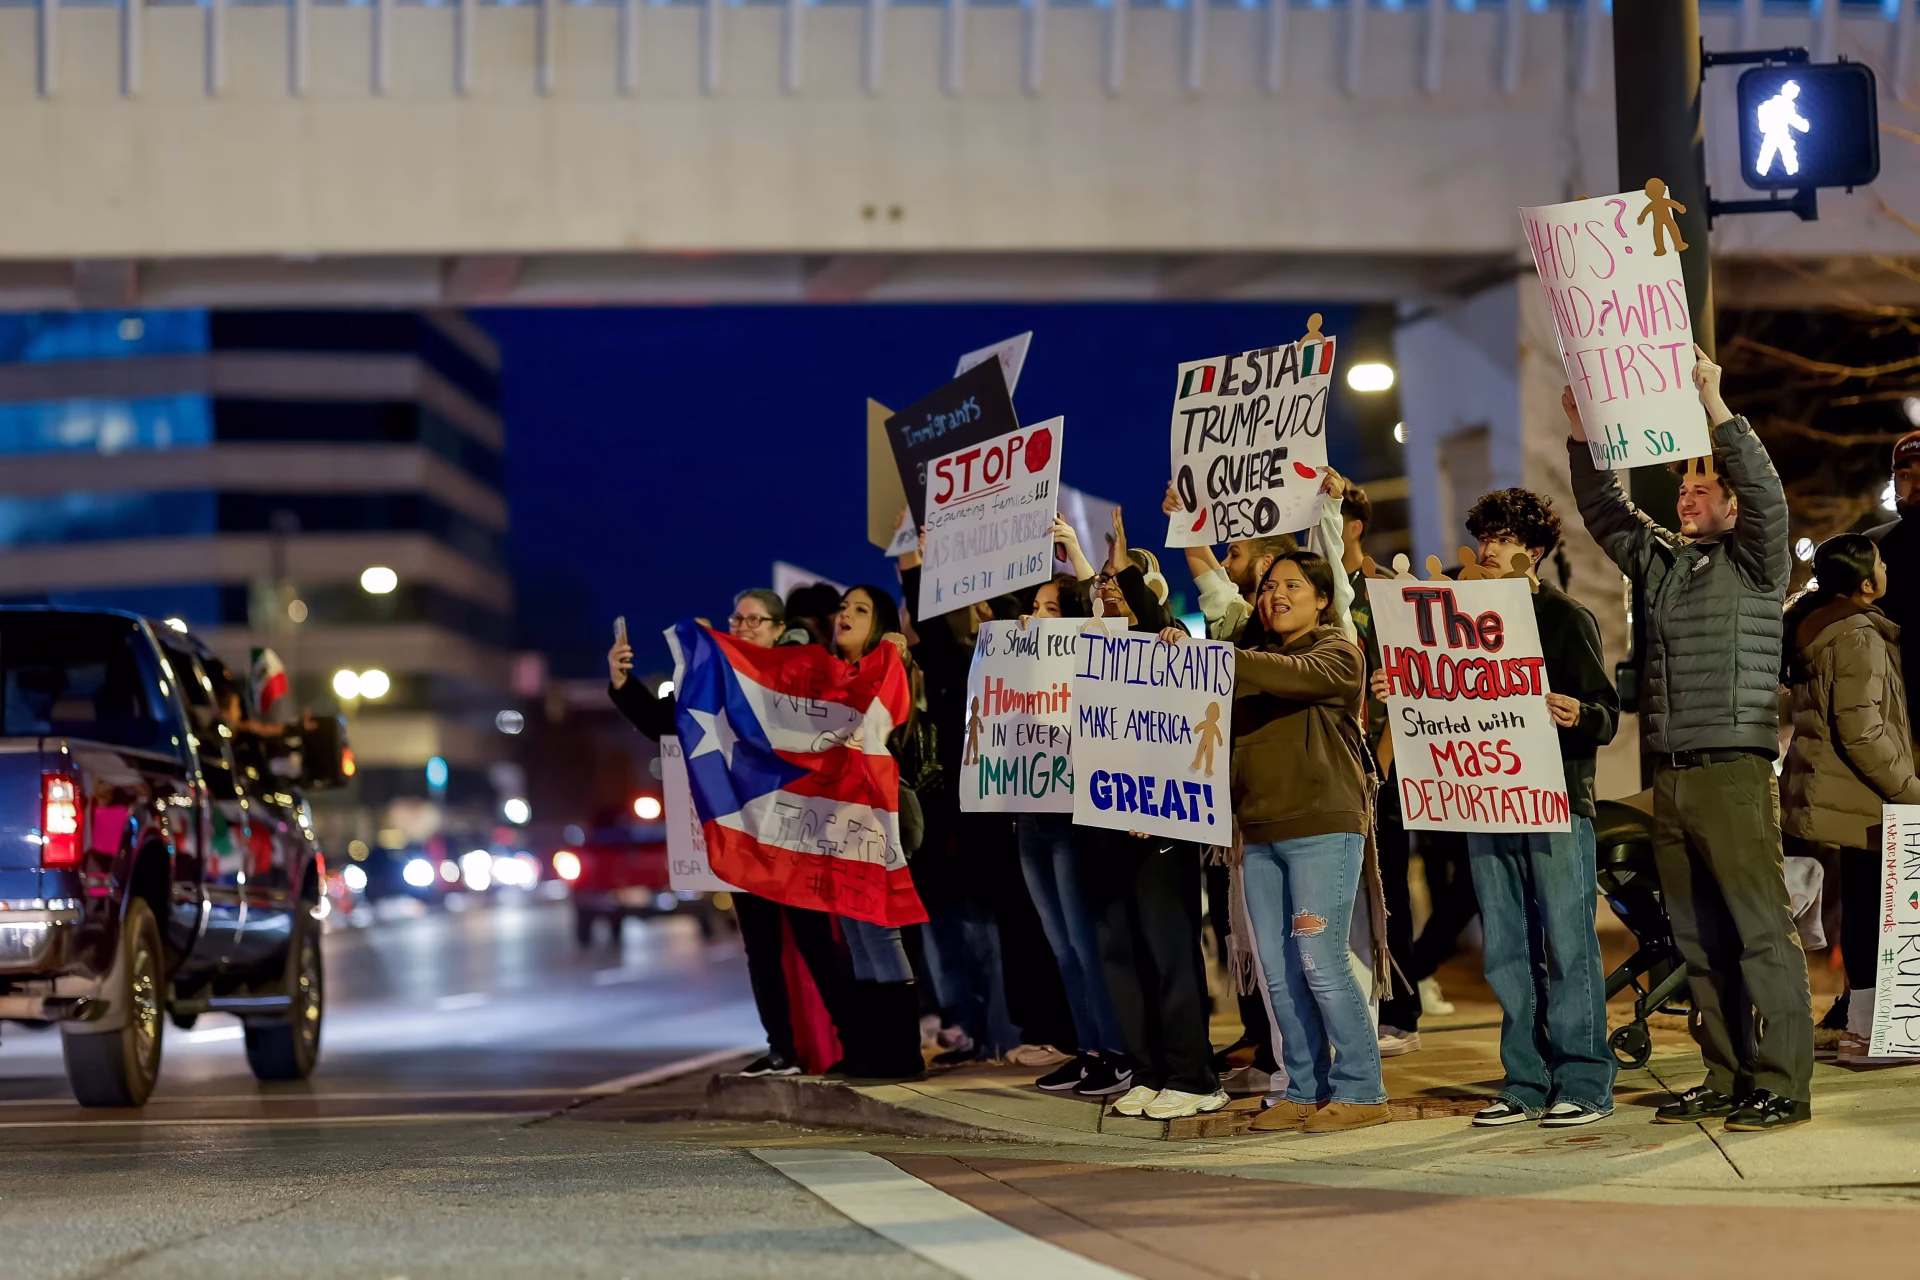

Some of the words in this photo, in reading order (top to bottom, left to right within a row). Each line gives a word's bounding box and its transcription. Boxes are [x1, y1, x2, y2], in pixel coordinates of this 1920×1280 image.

[1545, 285, 1614, 338] ND?
[1612, 279, 1688, 338] WAS
[1217, 342, 1299, 396] ESTA
[1576, 342, 1687, 403] FIRST
[901, 396, 981, 448] Immigrants
[1180, 386, 1328, 455] TRUMP-UDO
[934, 435, 1024, 504] STOP
[1177, 464, 1197, 513] O
[1206, 447, 1288, 500] QUIERE
[926, 502, 985, 532] Separating
[1211, 496, 1280, 544] BESO
[953, 570, 995, 595] estar
[1003, 552, 1043, 581] unidos
[977, 629, 995, 659] We
[1401, 587, 1504, 653] The
[1075, 632, 1233, 696] IMMIGRANTS
[983, 675, 1072, 717] Humanit
[992, 723, 1006, 747] IN
[1016, 723, 1072, 754] EVERY
[1079, 704, 1118, 740] MAKE
[1124, 708, 1192, 744] AMERICA
[1402, 707, 1471, 737] Started
[1478, 711, 1525, 734] with
[1089, 770, 1215, 825] GREAT!
[1402, 777, 1569, 825] DEPORTATION
[672, 859, 701, 876] USA
